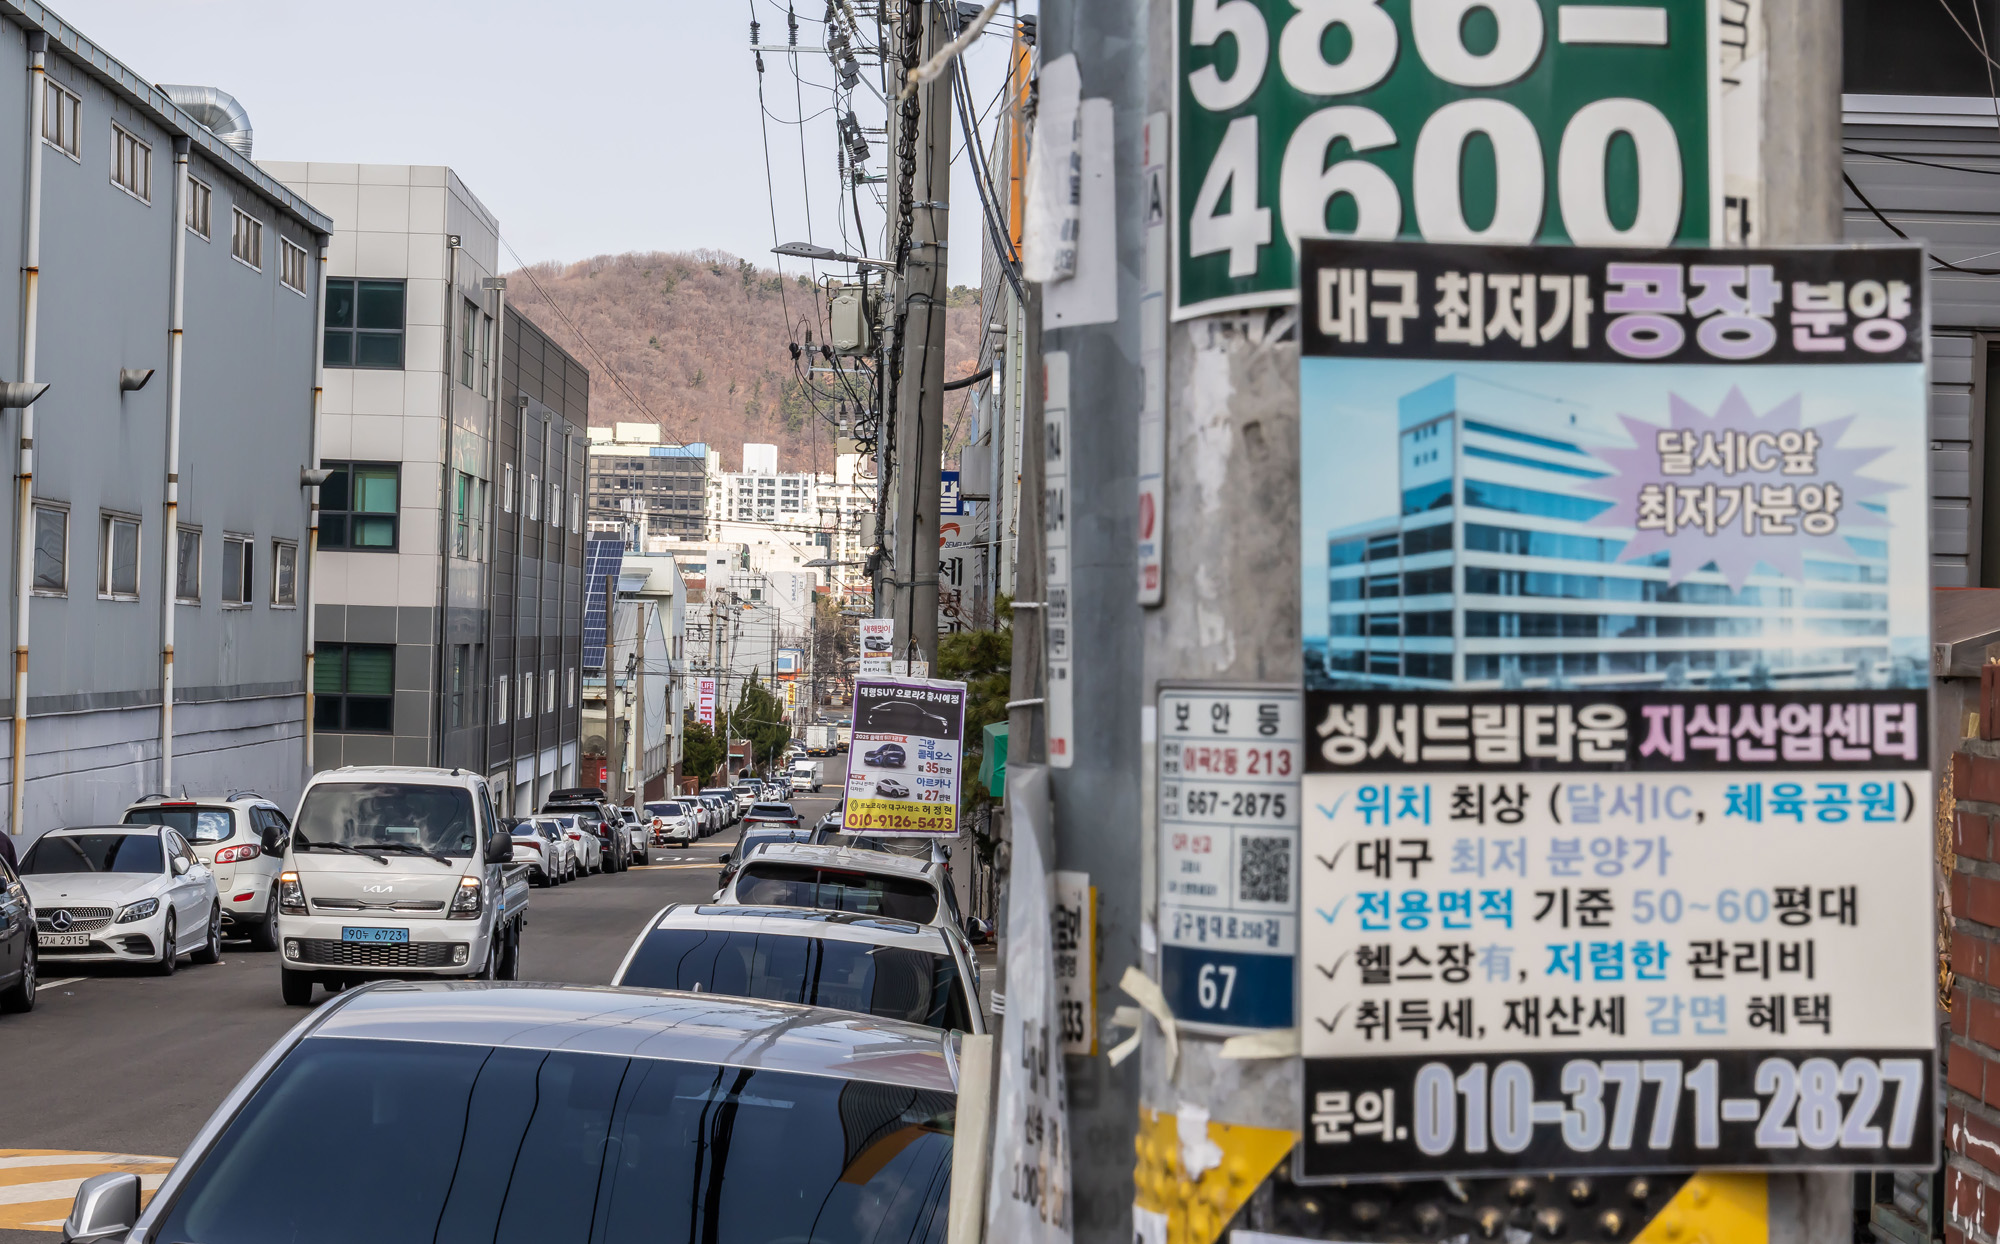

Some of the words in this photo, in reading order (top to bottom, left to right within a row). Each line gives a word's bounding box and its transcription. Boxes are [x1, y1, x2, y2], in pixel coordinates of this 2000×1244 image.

[1190, 98, 1684, 279] 4600
[1318, 269, 1418, 344] 대구
[1434, 273, 1593, 350] 최저가
[1605, 262, 1783, 359] 공장
[1791, 280, 1911, 353] 분양
[1657, 428, 1822, 476] 달서IC앞
[1637, 481, 1843, 537] 최저가분양
[863, 624, 891, 634] 새해맞이
[860, 687, 896, 698] 대형SUV
[895, 689, 926, 700] 오로라2
[926, 691, 960, 704] 출시예정
[918, 738, 936, 750] 그랑
[1316, 704, 1628, 765] 성서드림타운
[1640, 703, 1918, 763] 지식산업센터
[917, 749, 953, 761] 콜레오스
[1246, 748, 1293, 776] 213
[916, 777, 952, 788] 아르카나
[860, 802, 887, 811] 르노코리아
[888, 804, 920, 813] 대구사업소
[1187, 790, 1286, 819] 667-2875
[1354, 784, 1432, 826] 위치
[1450, 783, 1530, 825] 최상
[1548, 782, 1706, 826] (달서IC,
[1724, 780, 1916, 825] 체육공원)
[848, 813, 953, 830] 010-9126-5473
[1355, 839, 1433, 880] 대구
[1450, 838, 1530, 878] 최저
[1547, 836, 1673, 877] 분양가
[363, 885, 393, 893] KIA
[1355, 889, 1515, 931] 전용면적
[1533, 888, 1615, 928] 기준
[60, 935, 84, 946] 2915
[374, 930, 402, 941] 6723
[1546, 941, 1671, 984] 저렴한
[1687, 939, 1816, 981] 관리비
[1197, 963, 1238, 1010] 67
[1355, 997, 1487, 1040] 취득세,
[1503, 996, 1627, 1037] 재산세
[1644, 995, 1729, 1037] 감면
[1747, 994, 1834, 1034] 혜택
[1311, 1089, 1408, 1142] 문의.
[1414, 1057, 1924, 1156] 010-3771-2827
